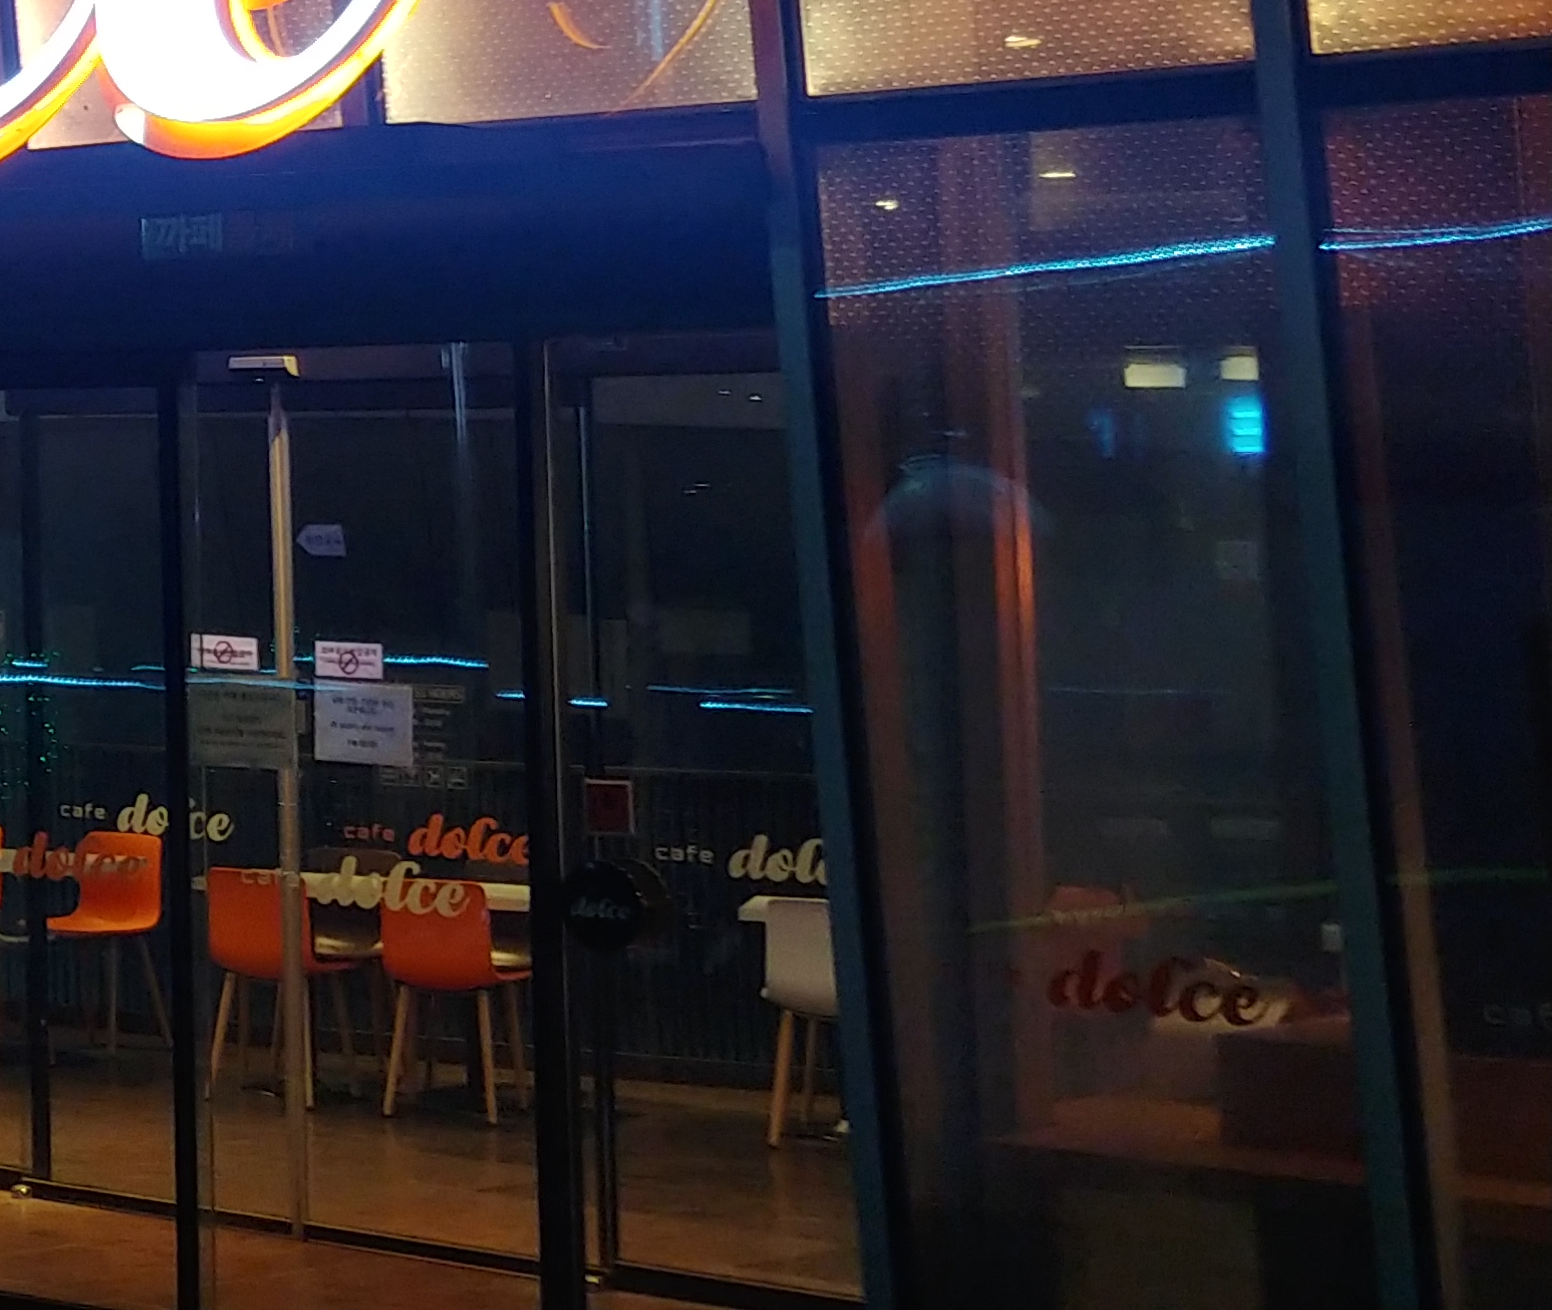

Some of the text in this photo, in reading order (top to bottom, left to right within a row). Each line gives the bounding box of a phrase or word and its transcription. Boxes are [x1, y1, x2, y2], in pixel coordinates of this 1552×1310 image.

[60, 792, 236, 843] cafe doce
[343, 823, 395, 842] cafe
[306, 855, 471, 917] dolce
[653, 833, 827, 888] cafe dol
[1048, 950, 1273, 1027] dolce
